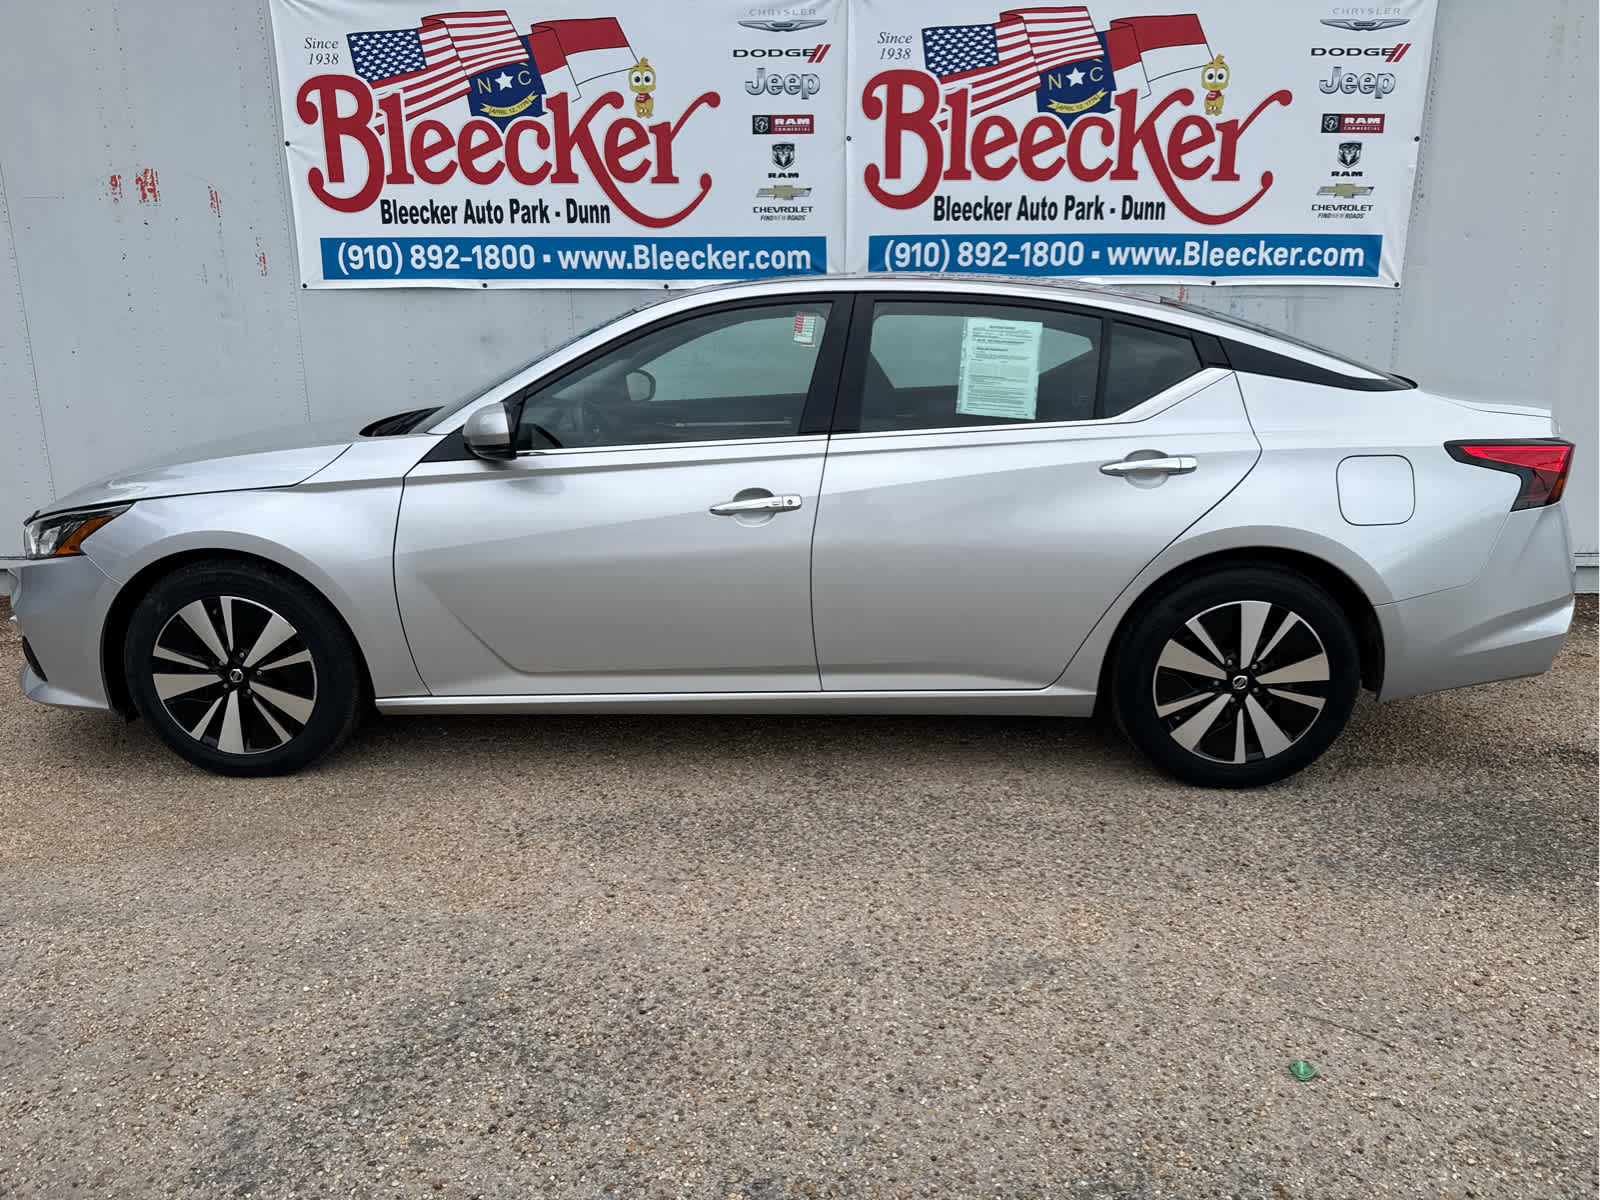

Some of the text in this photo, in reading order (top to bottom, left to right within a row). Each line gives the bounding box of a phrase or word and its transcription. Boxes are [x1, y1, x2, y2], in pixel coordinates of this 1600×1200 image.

[748, 8, 817, 16] CHRYSLER
[1332, 7, 1401, 16] CHRYSLER
[304, 37, 339, 49] Since
[877, 31, 913, 44] Since
[309, 53, 339, 65] 1938
[732, 48, 817, 57] DODGE
[880, 47, 912, 60] 1938
[1311, 47, 1396, 56] DODGE
[477, 70, 532, 94] N C
[744, 67, 821, 100] Jeep
[1048, 66, 1104, 90] N C
[1318, 66, 1397, 99] Jeep
[296, 73, 721, 229] Bleecker
[862, 69, 1293, 226] Bleecker
[380, 198, 458, 225] Bleecker
[463, 198, 504, 225] Auto
[508, 198, 551, 224] Park
[565, 198, 611, 224] Dunn
[933, 195, 1012, 221] Bleecker
[1016, 194, 1058, 221] Auto
[1063, 194, 1105, 220] Park
[1120, 194, 1166, 221] Dunn
[338, 241, 812, 275] (910) 892-1800 www.Bleecker.com
[884, 238, 1365, 272] (910) 892-1800 www.Bleecker.com
